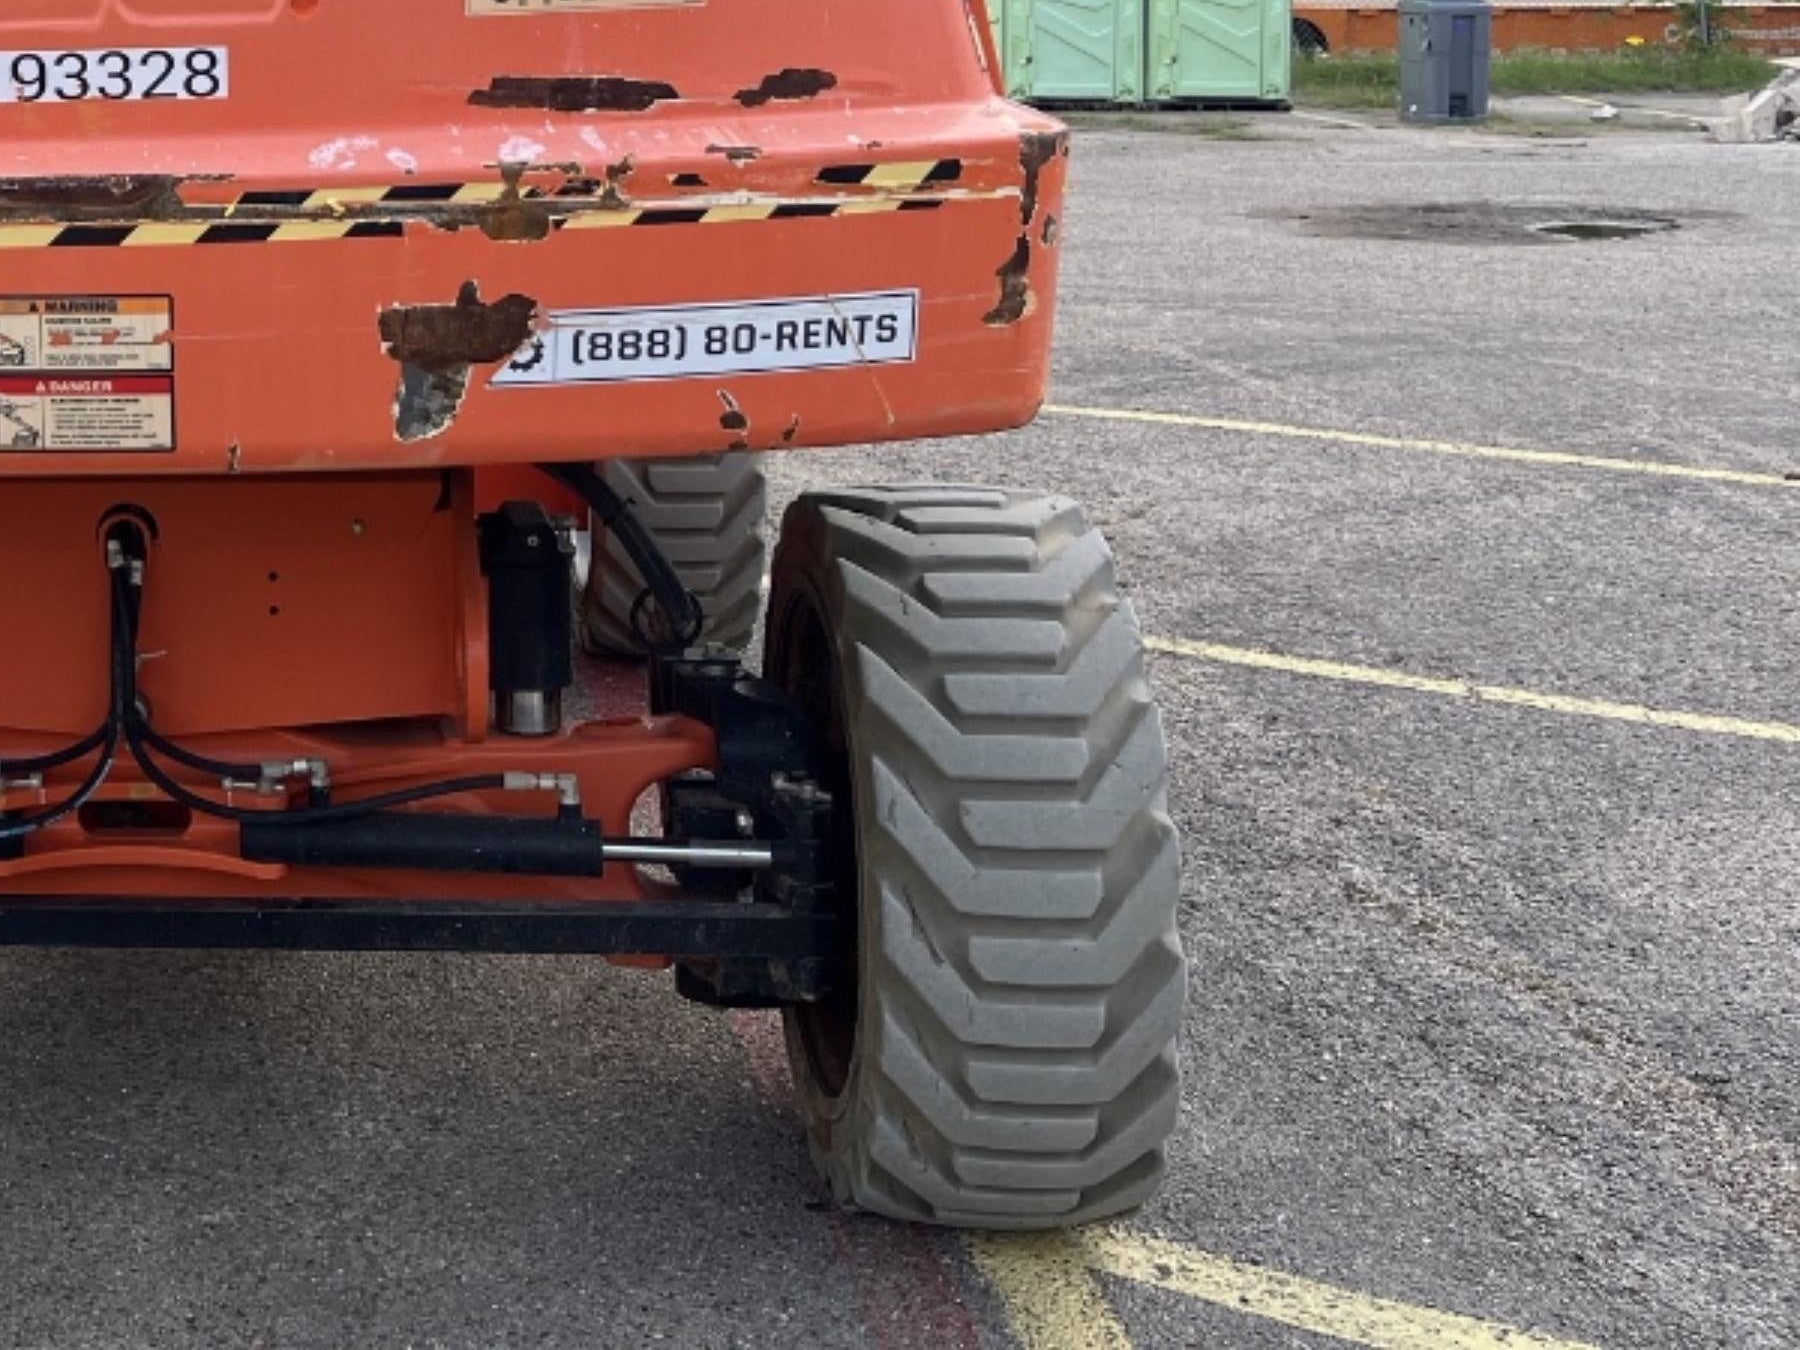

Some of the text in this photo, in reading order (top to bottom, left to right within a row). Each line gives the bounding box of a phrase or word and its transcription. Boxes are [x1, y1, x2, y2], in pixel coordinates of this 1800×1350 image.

[571, 313, 899, 365] (888) 80-RENTS
[49, 380, 113, 394] DANGER
